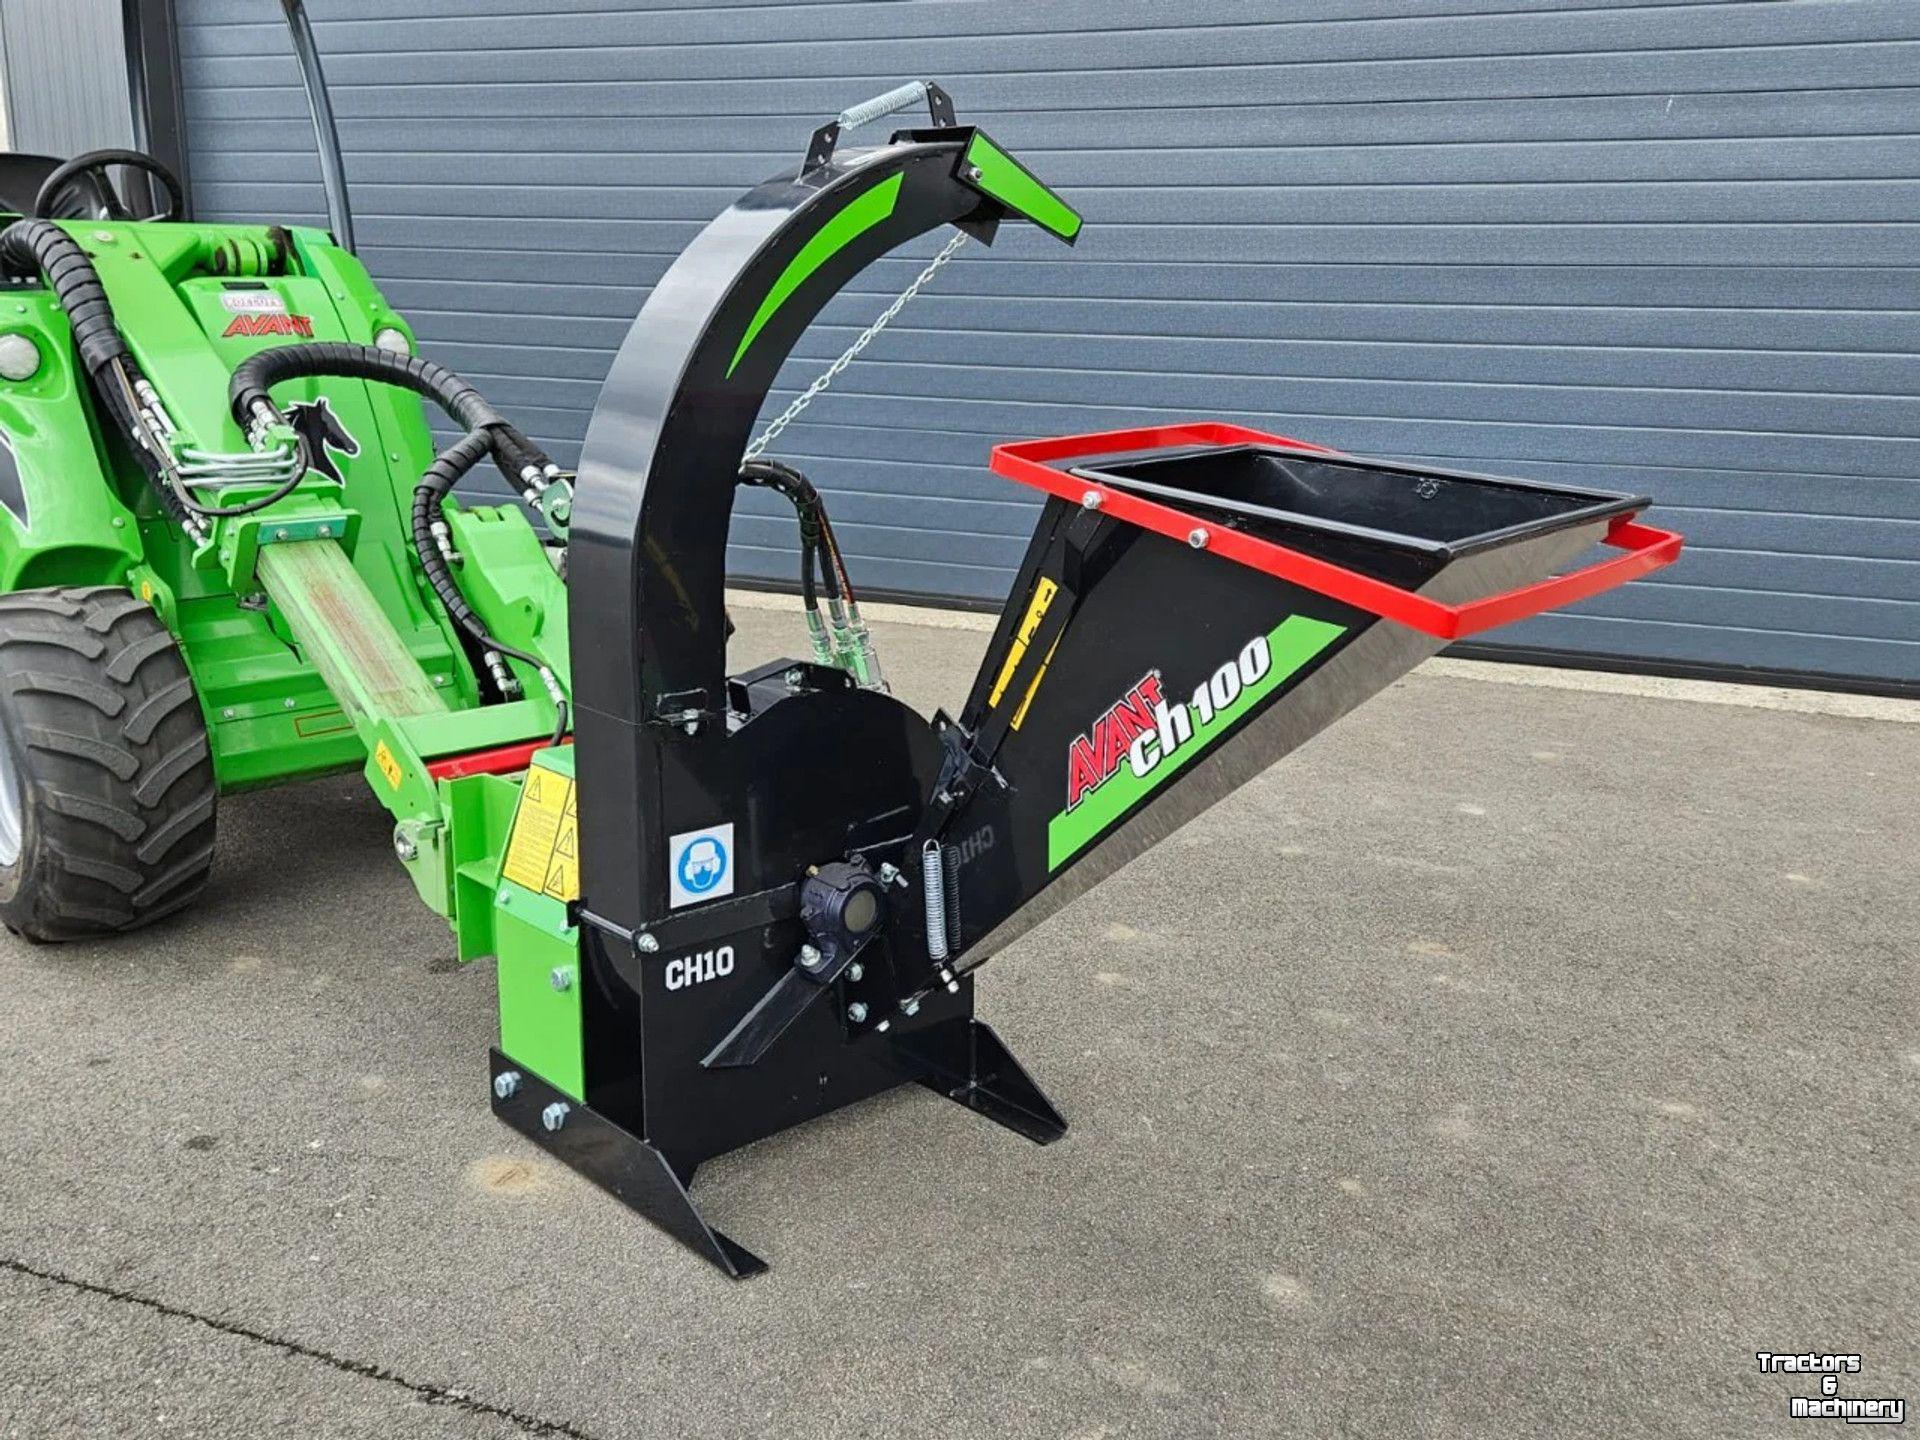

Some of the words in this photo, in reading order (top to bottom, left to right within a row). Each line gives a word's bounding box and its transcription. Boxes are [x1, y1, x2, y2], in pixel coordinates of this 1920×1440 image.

[222, 314, 314, 337] AVANT
[1067, 669, 1163, 813] AVANT
[666, 946, 734, 990] CH10
